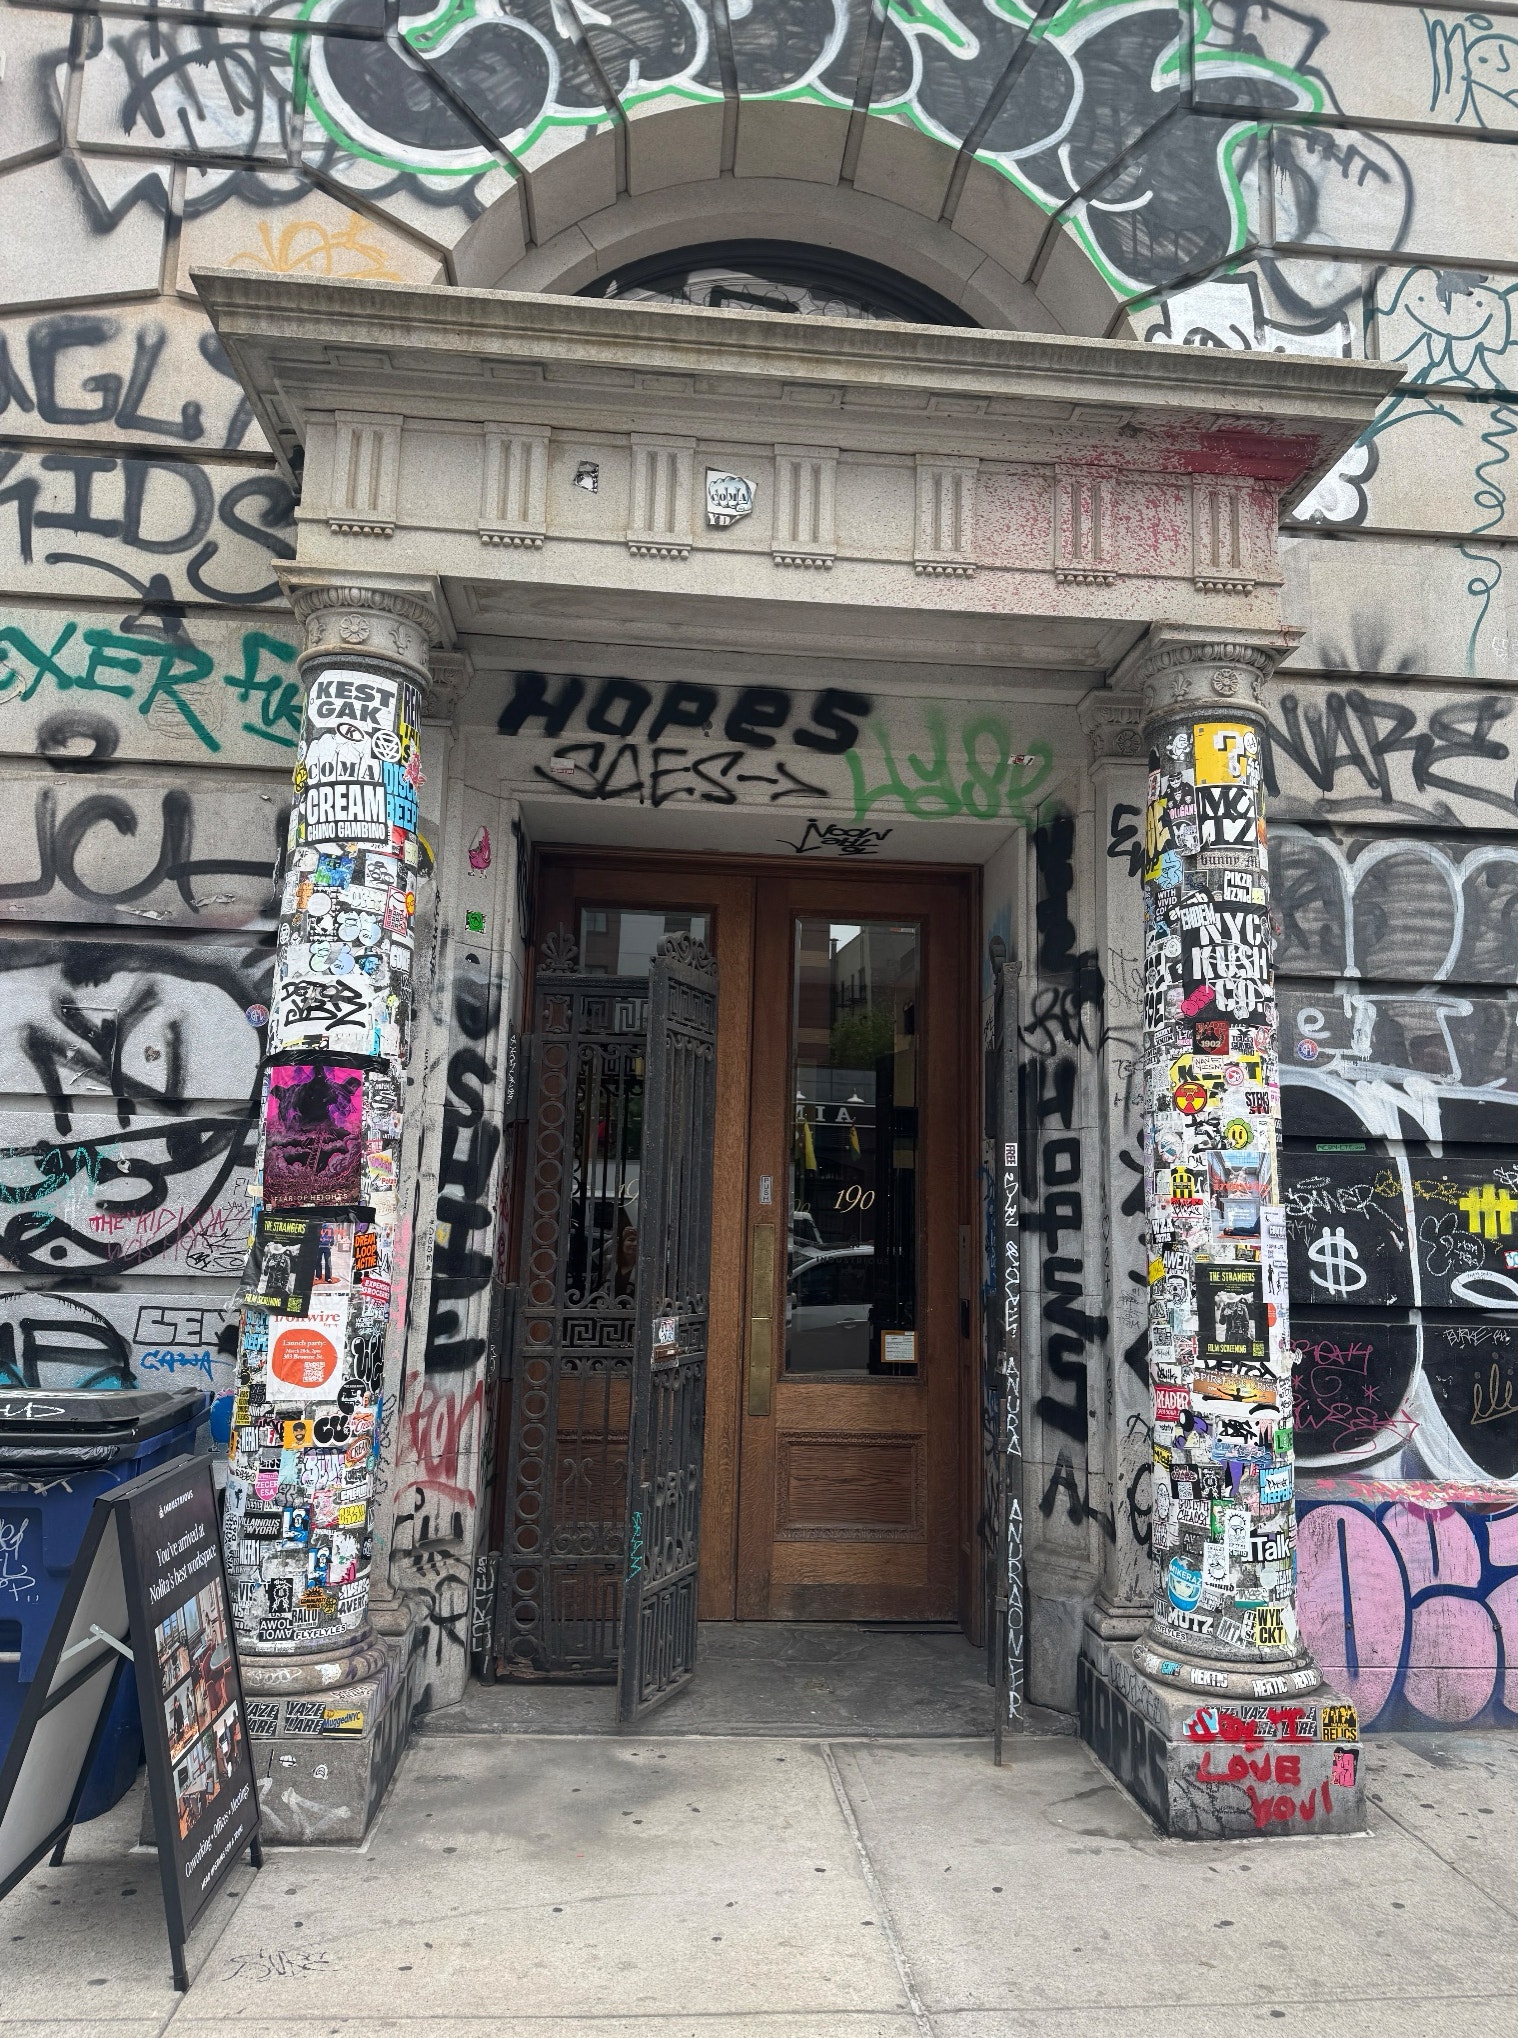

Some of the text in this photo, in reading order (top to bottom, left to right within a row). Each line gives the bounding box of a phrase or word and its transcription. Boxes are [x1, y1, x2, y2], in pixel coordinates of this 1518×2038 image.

[316, 681, 395, 708] KEST
[317, 701, 382, 726] GAK
[308, 760, 375, 780] COMA
[307, 785, 385, 825] CREAM
[307, 822, 385, 841] CHINO GAMBINO
[1158, 889, 1176, 899] WITH
[1158, 897, 1177, 907] VIVID
[1200, 912, 1261, 945] NYC
[1192, 946, 1268, 980] KUSH
[1201, 1040, 1220, 1048] 1902
[833, 1185, 875, 1213] 190
[355, 1234, 376, 1247] DREAM
[356, 1245, 376, 1259] LOOP
[1209, 1271, 1255, 1282] THE STRANGERS
[1207, 1344, 1247, 1353] FILM SCREENING
[1156, 1390, 1190, 1409] READER
[156, 1540, 178, 1566] You've
[177, 1526, 199, 1556] arrived
[150, 1544, 217, 1605] Nolita's best workspace
[260, 1620, 293, 1630] AWOL
[295, 1624, 346, 1639] FLYFLYLES
[1260, 1627, 1283, 1644] CKT
[1252, 1677, 1288, 1697] HEKTIC
[323, 1711, 360, 1728] MuggedNYC
[1323, 1728, 1357, 1740] RELICS
[1196, 1752, 1301, 1786] LOVE
[185, 1783, 250, 1878] Coworking Offices Meetings
